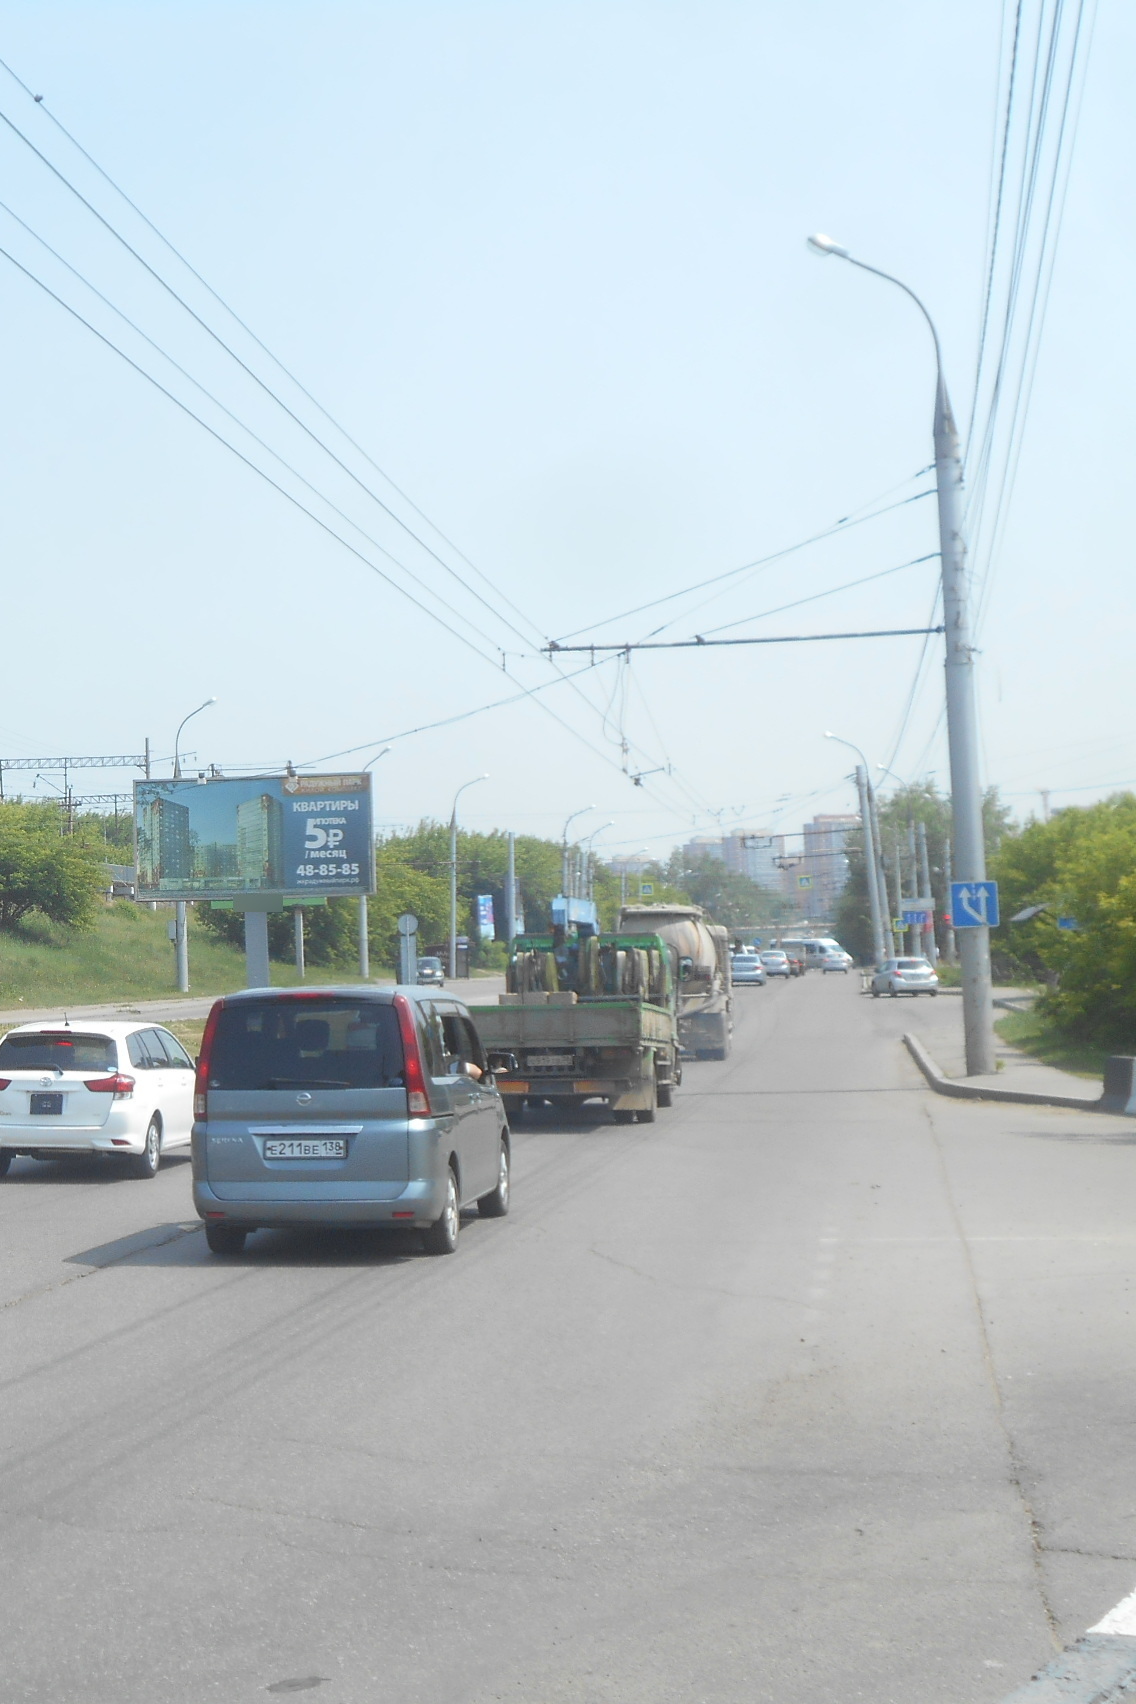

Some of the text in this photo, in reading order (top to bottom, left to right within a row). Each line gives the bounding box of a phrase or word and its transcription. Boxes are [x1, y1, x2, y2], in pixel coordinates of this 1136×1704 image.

[292, 800, 359, 812] КВАРТИРЫ
[296, 863, 360, 876] 48-85-85
[322, 1141, 341, 1152] 138
